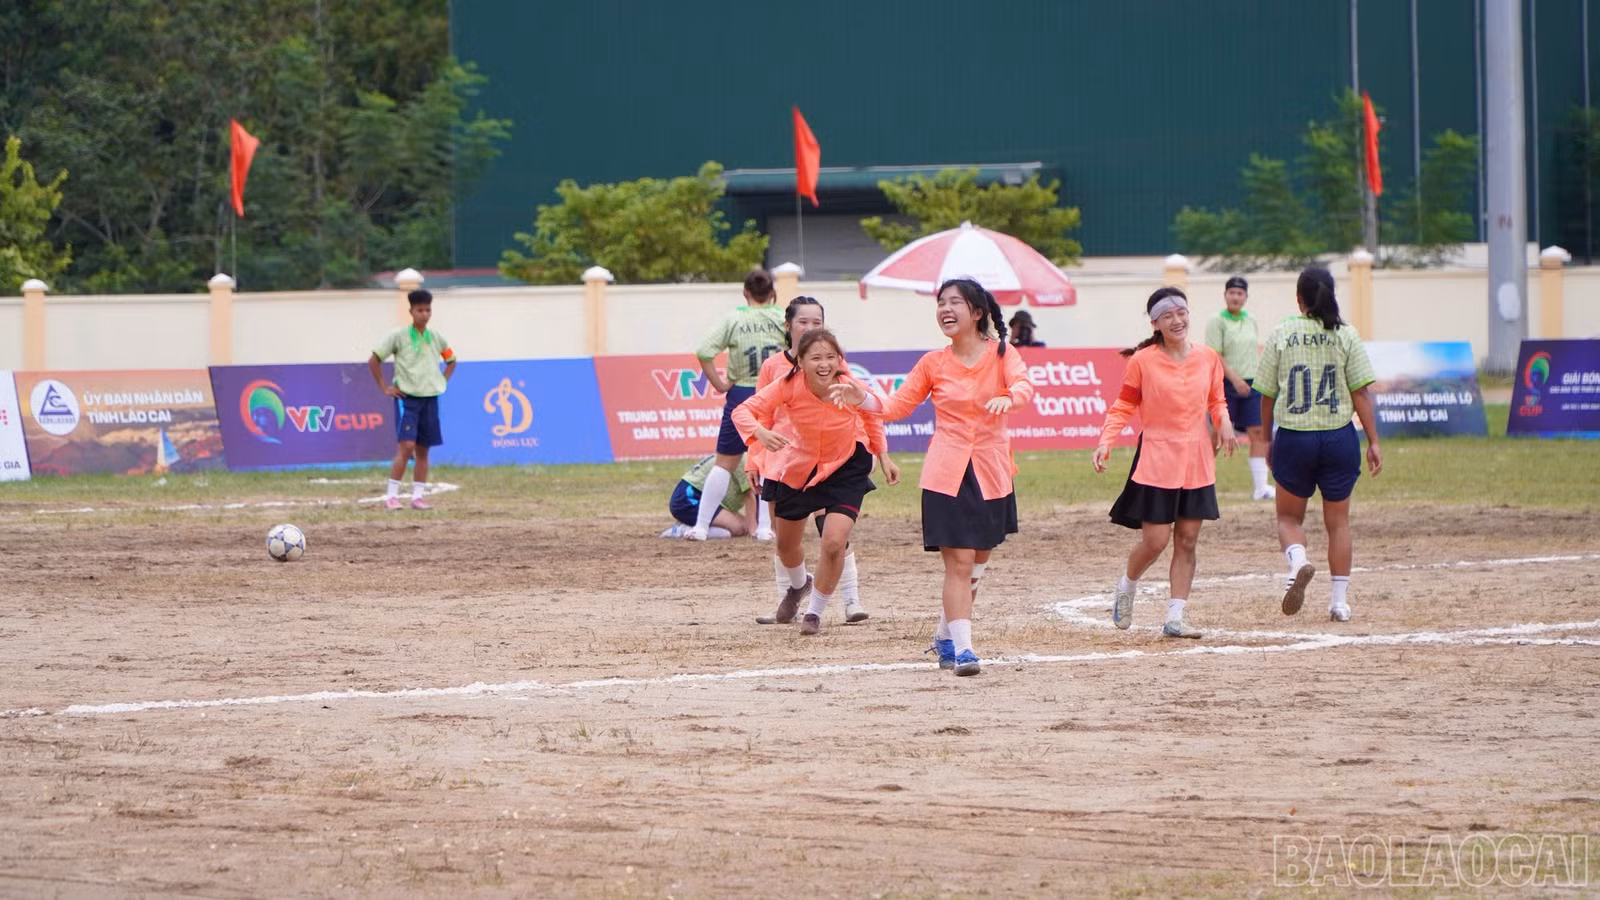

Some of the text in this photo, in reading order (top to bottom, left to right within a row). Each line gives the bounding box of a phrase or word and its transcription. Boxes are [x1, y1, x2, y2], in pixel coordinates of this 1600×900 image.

[1286, 363, 1340, 415] 04
[103, 392, 133, 405] BAN
[148, 409, 172, 422] CAI
[286, 405, 384, 432] VTV CUP
[617, 410, 658, 423] TRUNG
[3, 461, 21, 470] GIA
